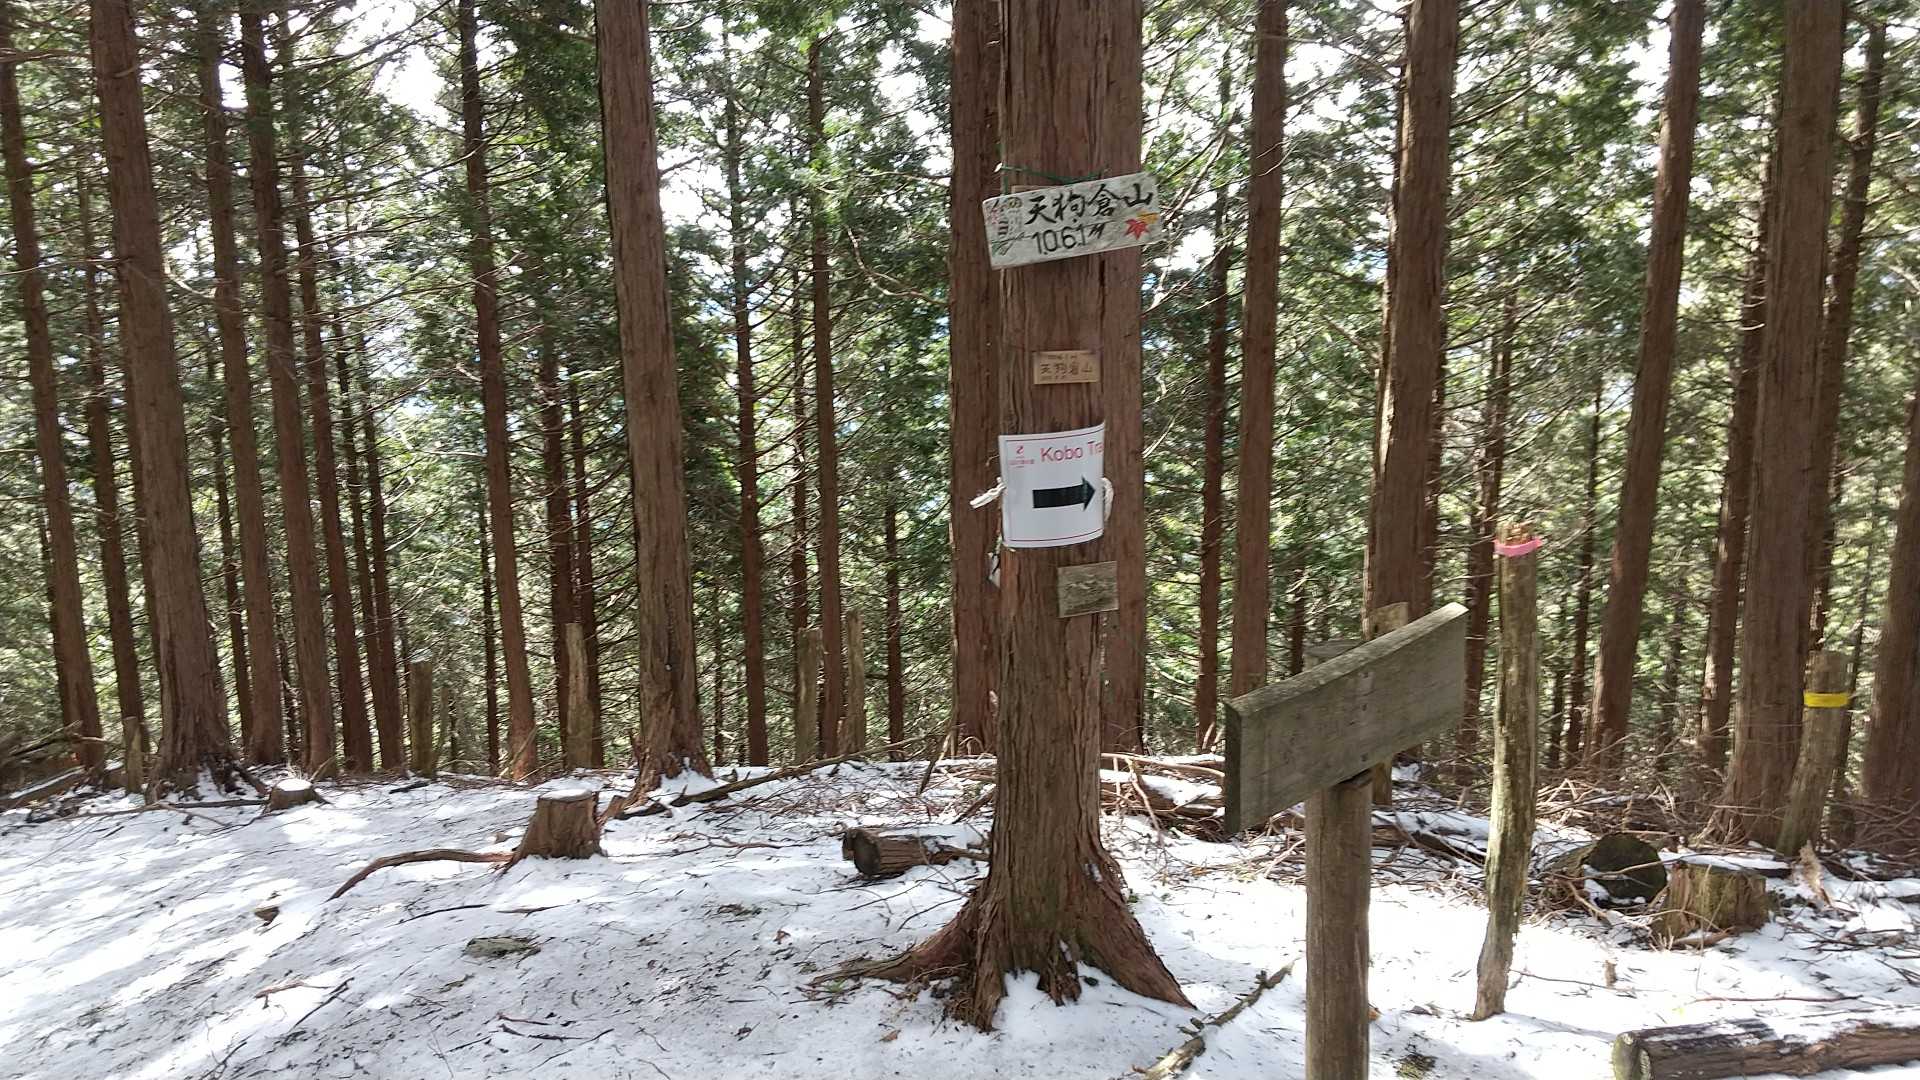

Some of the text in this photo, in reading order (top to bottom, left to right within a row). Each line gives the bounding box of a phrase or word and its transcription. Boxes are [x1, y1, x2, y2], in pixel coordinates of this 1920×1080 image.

[1025, 183, 1152, 226] 天狗倉山
[1040, 446, 1084, 462] Kobo
